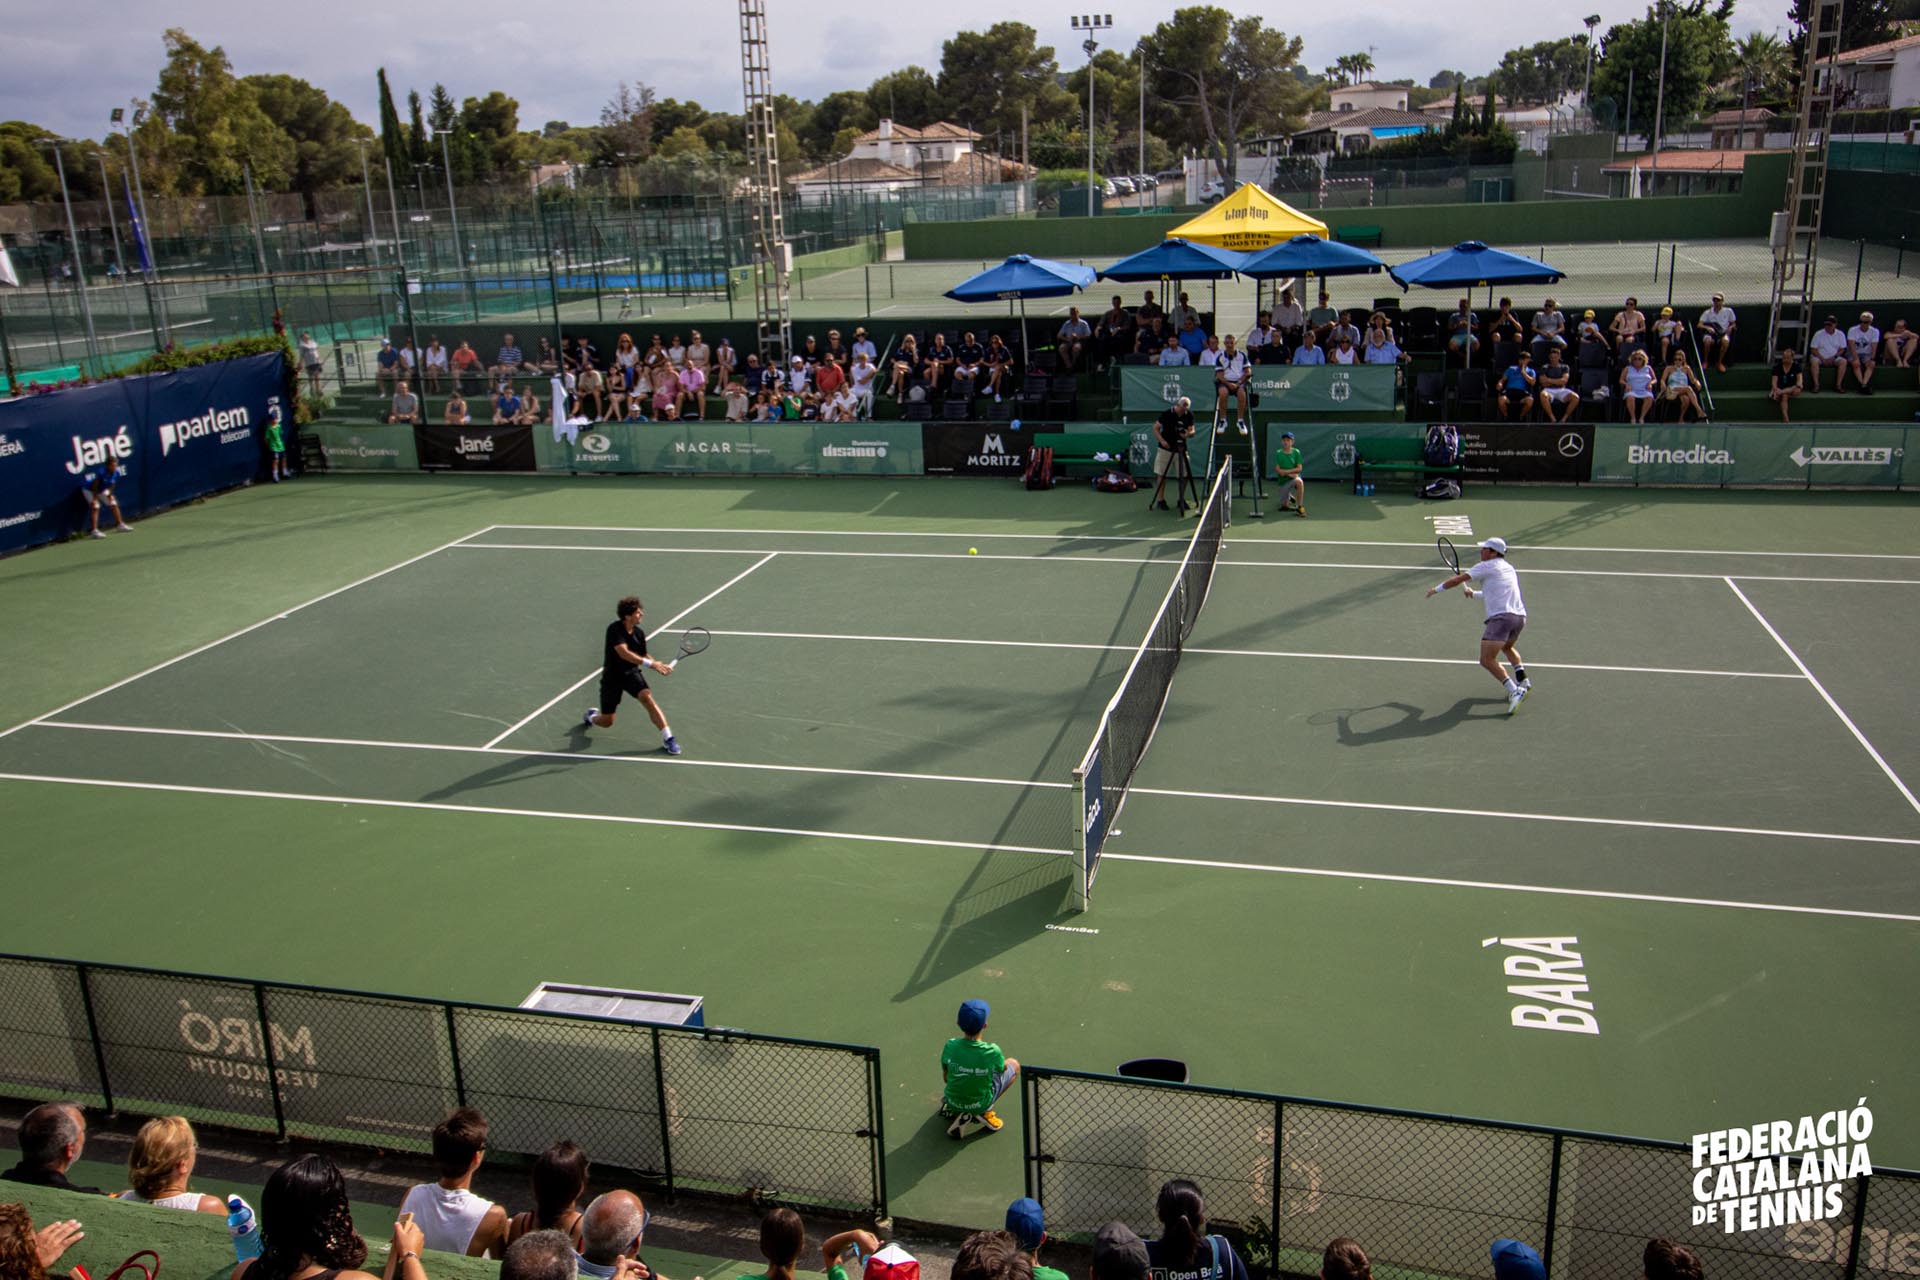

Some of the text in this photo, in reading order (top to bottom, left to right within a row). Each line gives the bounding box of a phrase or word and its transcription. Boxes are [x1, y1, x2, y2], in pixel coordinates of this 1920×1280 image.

[1332, 372, 1350, 380] CTB
[176, 406, 250, 448] parlem
[220, 428, 251, 444] telecom
[455, 435, 494, 454] Jané
[66, 425, 132, 474] Jané
[675, 442, 731, 453] NACAR
[1627, 444, 1735, 465] Bimedica.
[1819, 448, 1887, 462] VALLÈS
[967, 455, 1021, 466] MORITZ
[0, 510, 43, 529] TennisTour
[1481, 935, 1600, 1036] BARÀ
[1169, 1270, 1198, 1280] Open
